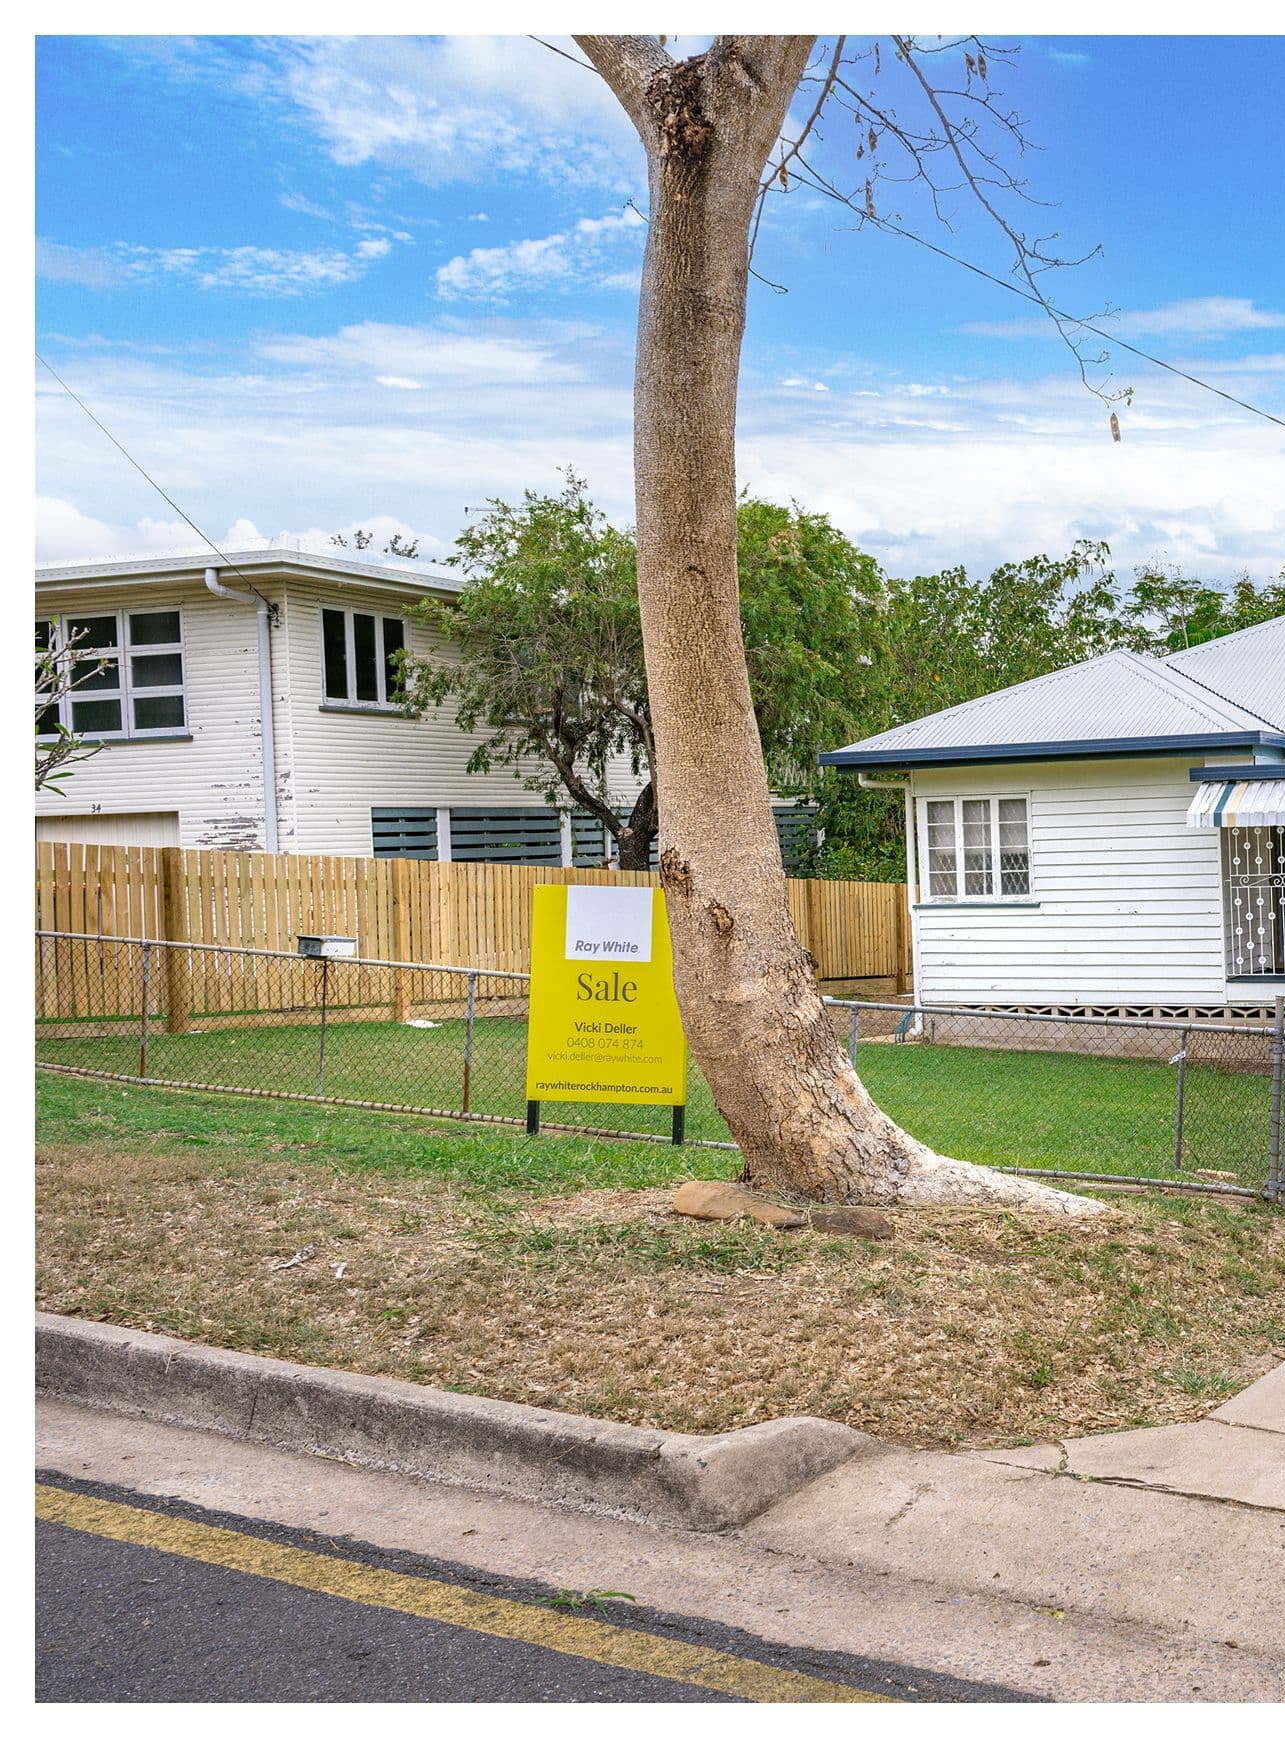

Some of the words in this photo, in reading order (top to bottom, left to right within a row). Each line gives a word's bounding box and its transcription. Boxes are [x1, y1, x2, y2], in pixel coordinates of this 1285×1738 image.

[91, 803, 101, 813] 34
[575, 940, 600, 954] Ray
[602, 941, 639, 954] White
[576, 972, 637, 1002] Sale
[575, 1022, 602, 1033] Vicki
[604, 1023, 638, 1034] Deller
[567, 1037, 595, 1048] 0408
[598, 1038, 619, 1049] 074
[623, 1039, 643, 1050] 874
[548, 1051, 662, 1064] vicki.deller@raywhite.com
[536, 1081, 673, 1094] raywhiterockhampton.com.au
